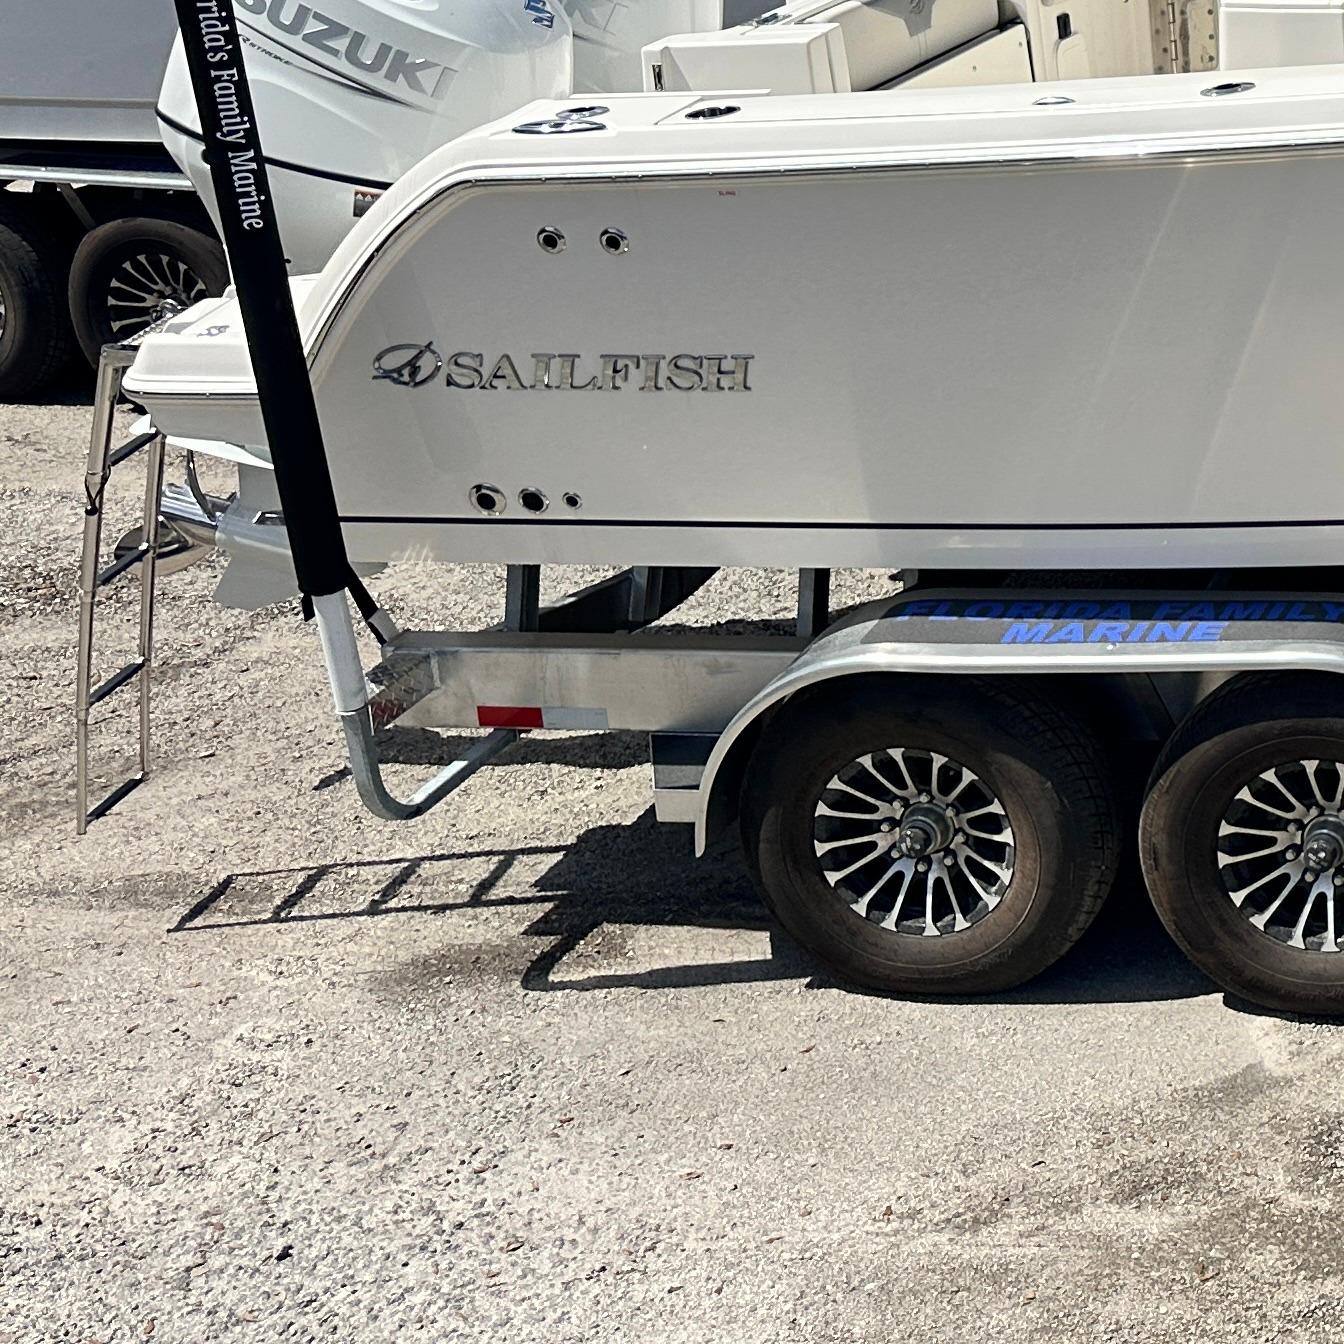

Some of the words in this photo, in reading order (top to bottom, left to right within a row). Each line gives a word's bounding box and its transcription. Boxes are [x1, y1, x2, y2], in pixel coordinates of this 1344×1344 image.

[209, 67, 248, 144] Family
[227, 149, 265, 231] Marine
[446, 352, 755, 392] SAILFISH
[896, 599, 1133, 622] FLORIDA
[1000, 621, 1230, 644] MARINE
